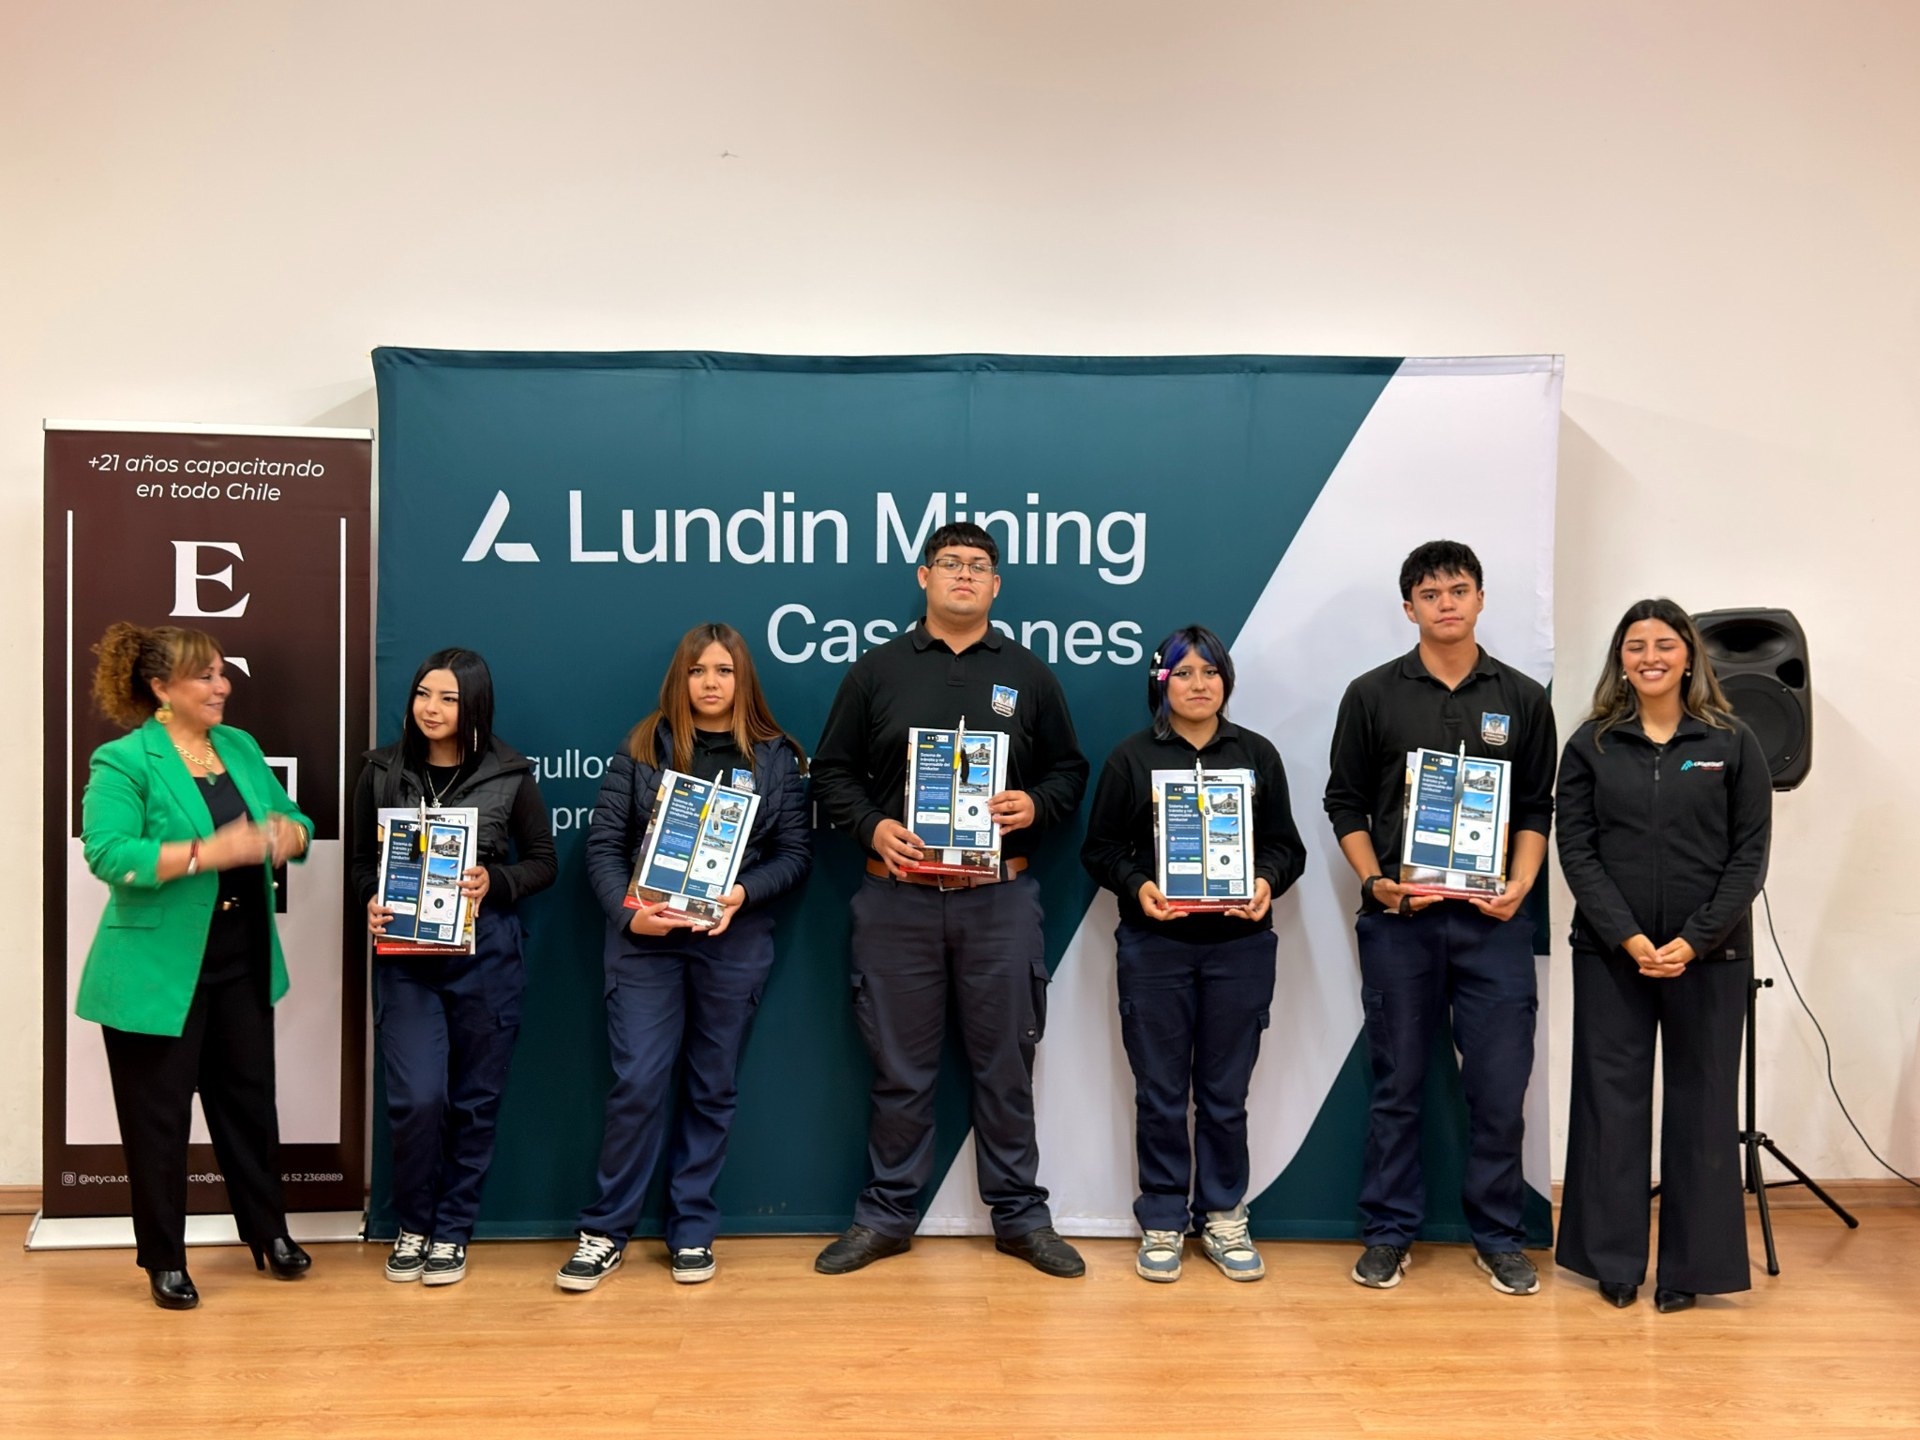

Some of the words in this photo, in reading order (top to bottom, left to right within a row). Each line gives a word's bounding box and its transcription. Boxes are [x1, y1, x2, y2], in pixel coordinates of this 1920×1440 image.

[88, 454, 119, 471] +21
[125, 454, 179, 473] años
[184, 457, 325, 478] capacitando
[136, 483, 163, 498] en
[170, 481, 220, 500] todo
[226, 482, 281, 501] Chile
[569, 489, 849, 565] Lundin
[169, 540, 250, 618] E
[766, 602, 1144, 666] Casnes
[552, 806, 595, 837] pr
[79, 1173, 130, 1184] @etyca.ot
[291, 1174, 302, 1182] 52
[304, 1174, 343, 1182] 2368889
